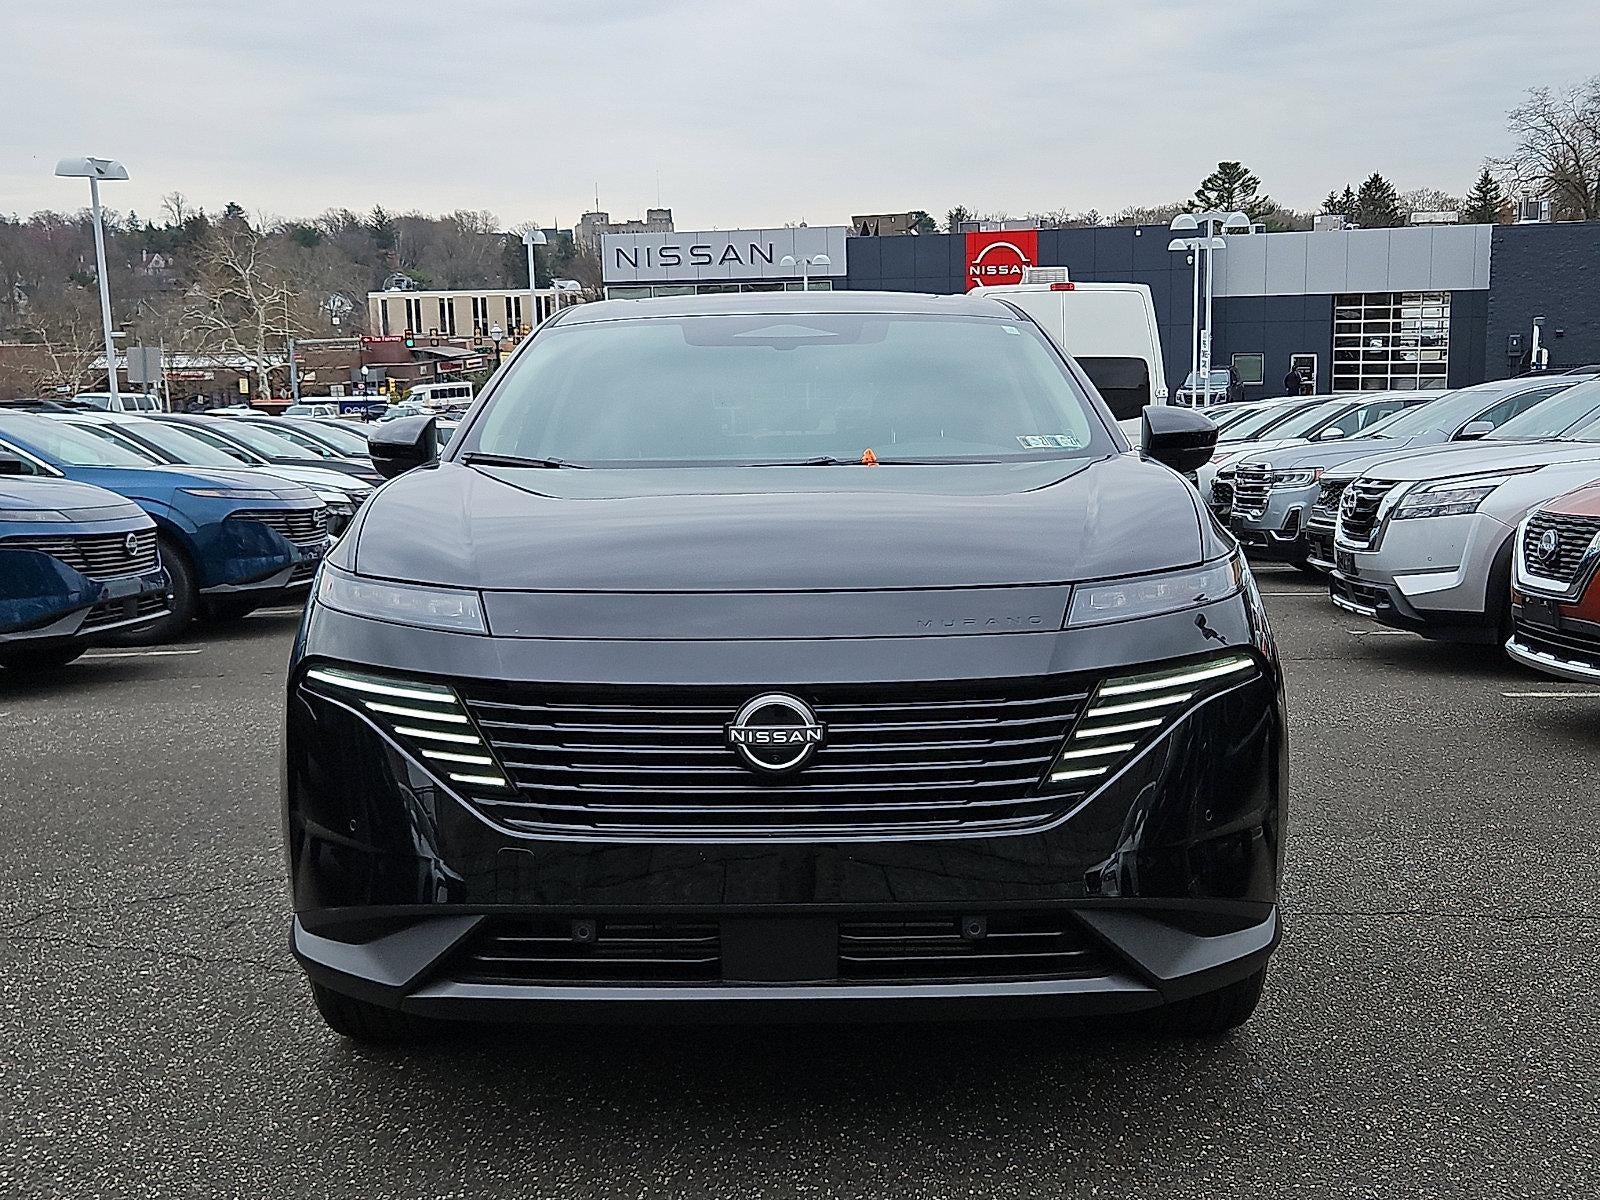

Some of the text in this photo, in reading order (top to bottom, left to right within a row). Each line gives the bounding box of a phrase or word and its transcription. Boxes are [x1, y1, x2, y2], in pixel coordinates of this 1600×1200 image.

[615, 242, 775, 269] NISSAN
[916, 615, 1042, 628] MURANO
[730, 728, 822, 743] NISSAN
